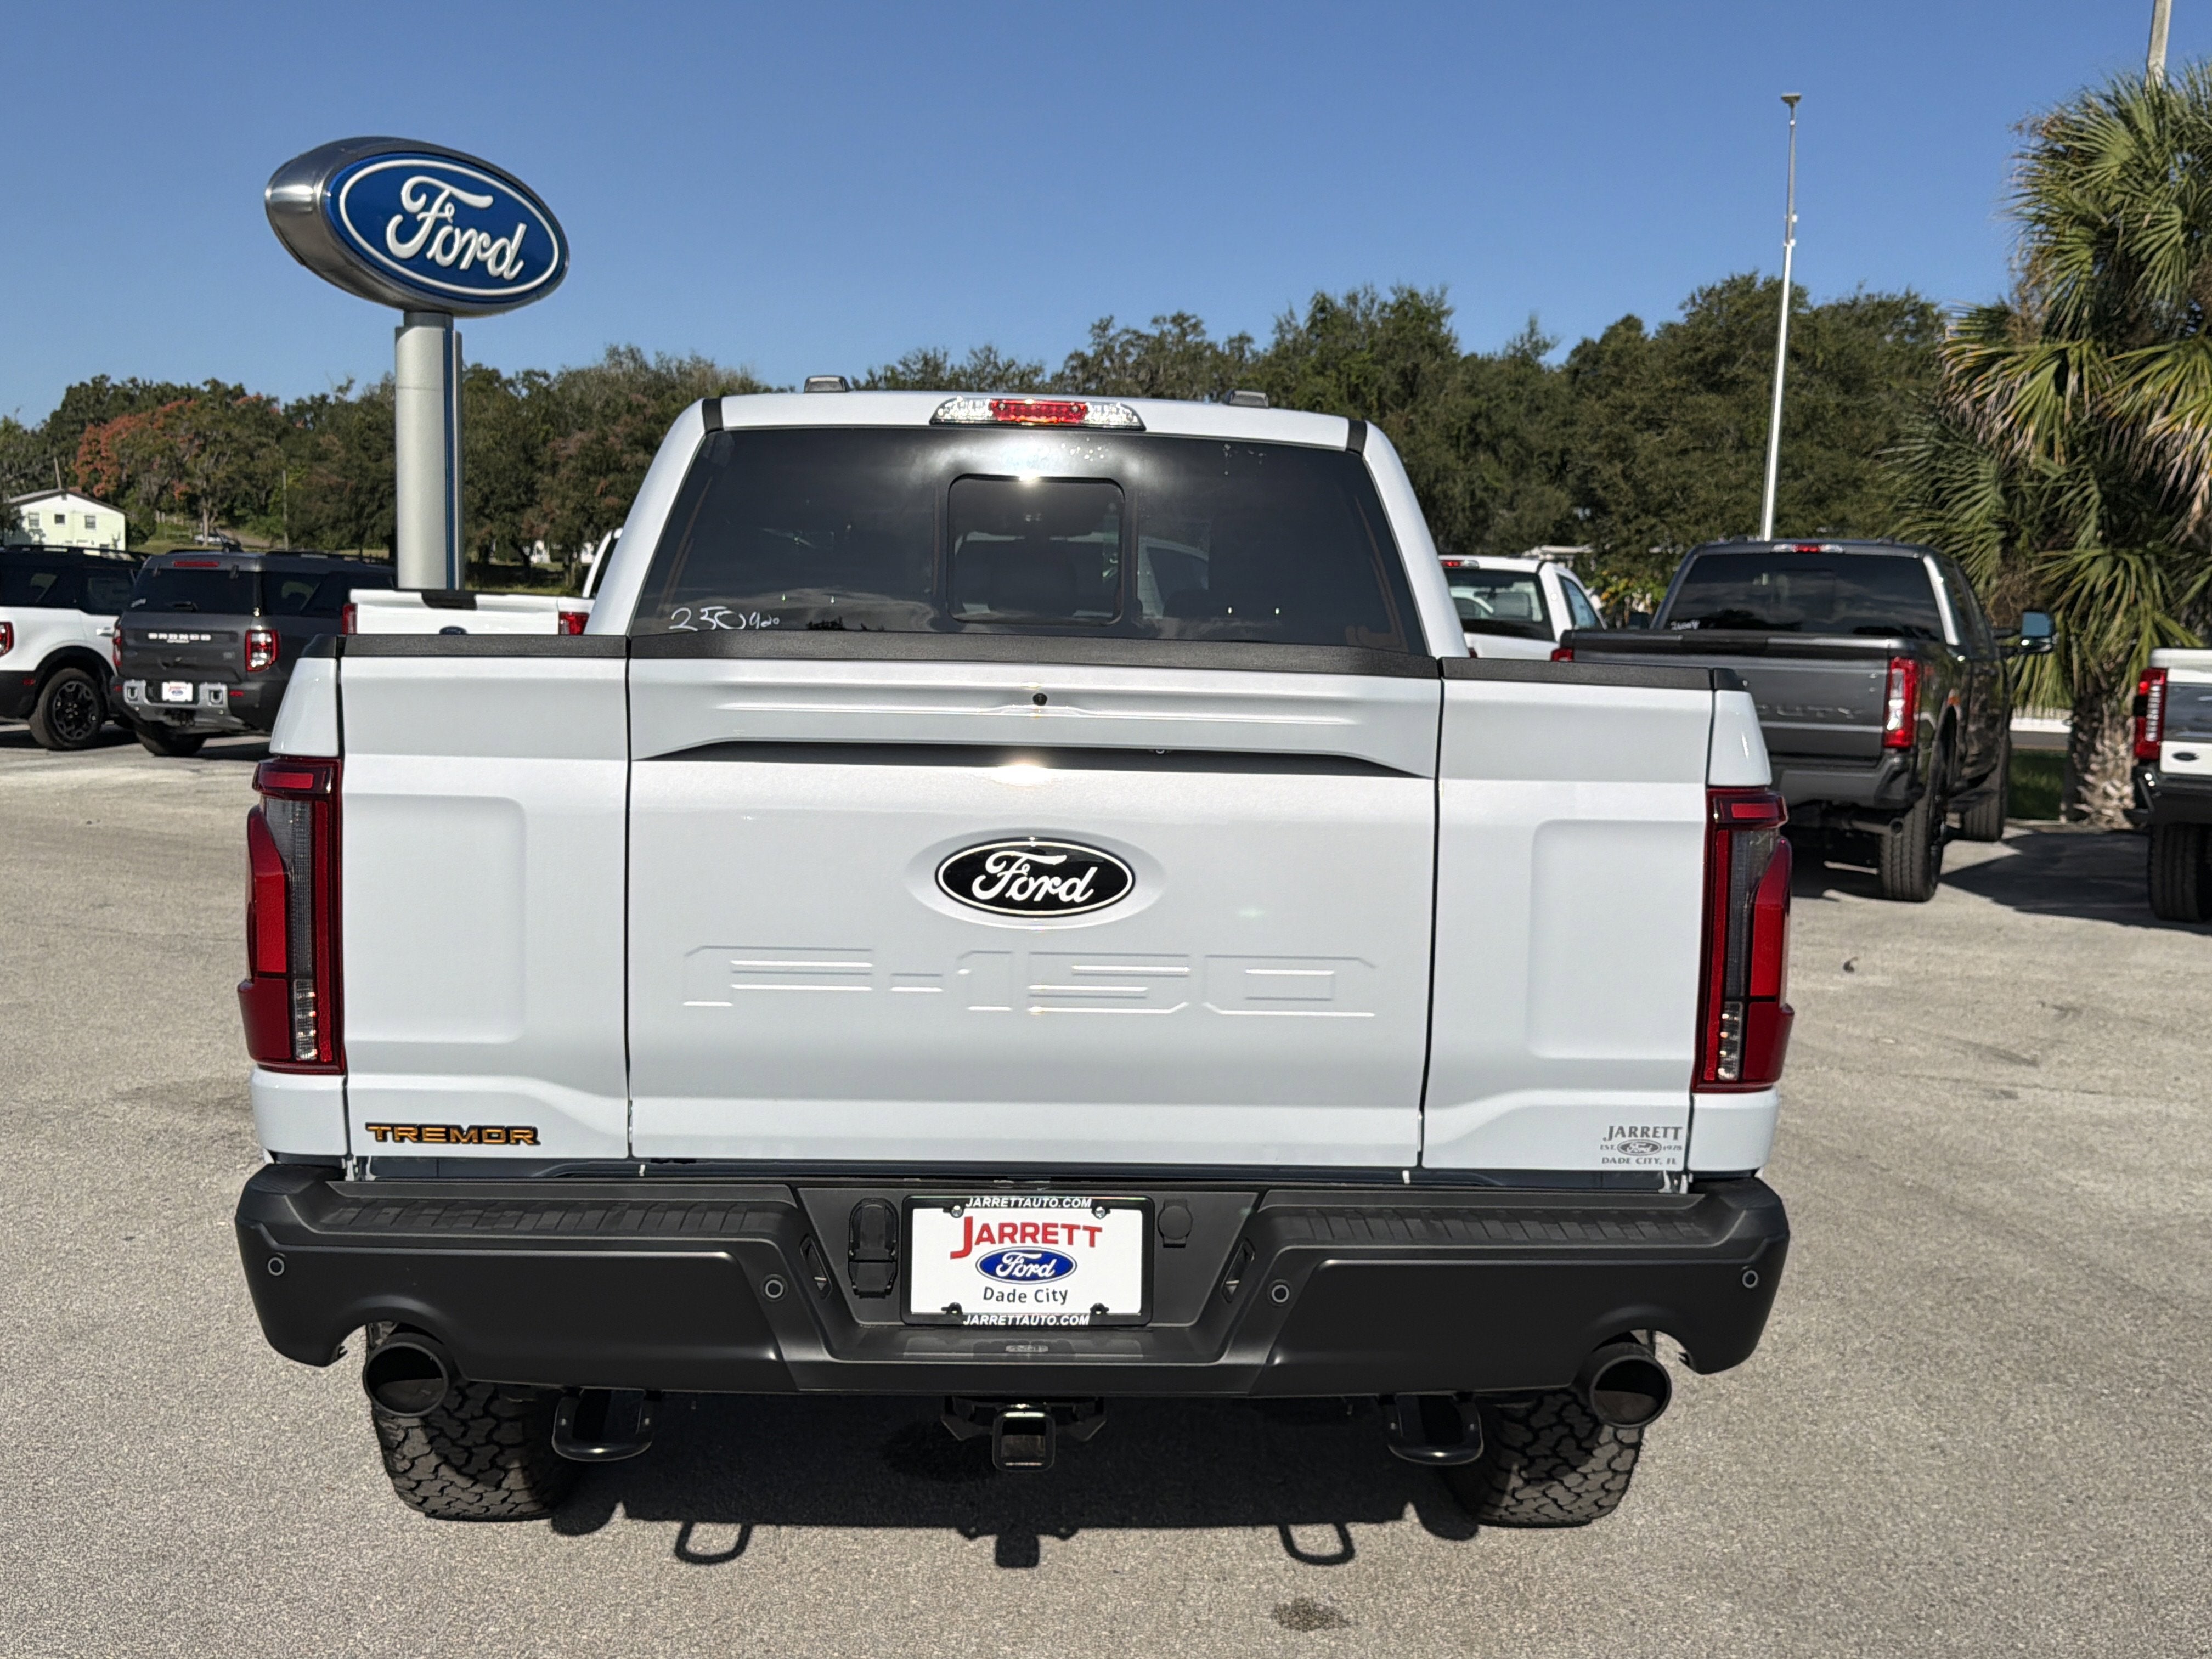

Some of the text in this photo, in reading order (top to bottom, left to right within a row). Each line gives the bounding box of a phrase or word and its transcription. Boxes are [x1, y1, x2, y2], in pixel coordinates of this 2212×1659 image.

[386, 175, 527, 280] Ford
[972, 850, 1098, 903] Ford
[684, 945, 1376, 1017] F-150
[365, 1122, 541, 1146] TREMOR
[1602, 1125, 1683, 1142] JARRETT
[966, 1197, 1092, 1207] JARRETTAUTO.COM
[950, 1216, 1103, 1259] JARRETT
[996, 1251, 1056, 1278] Ford
[983, 1286, 1068, 1305] Dade City
[963, 1314, 1090, 1325] JARRETTAUTO.COM
